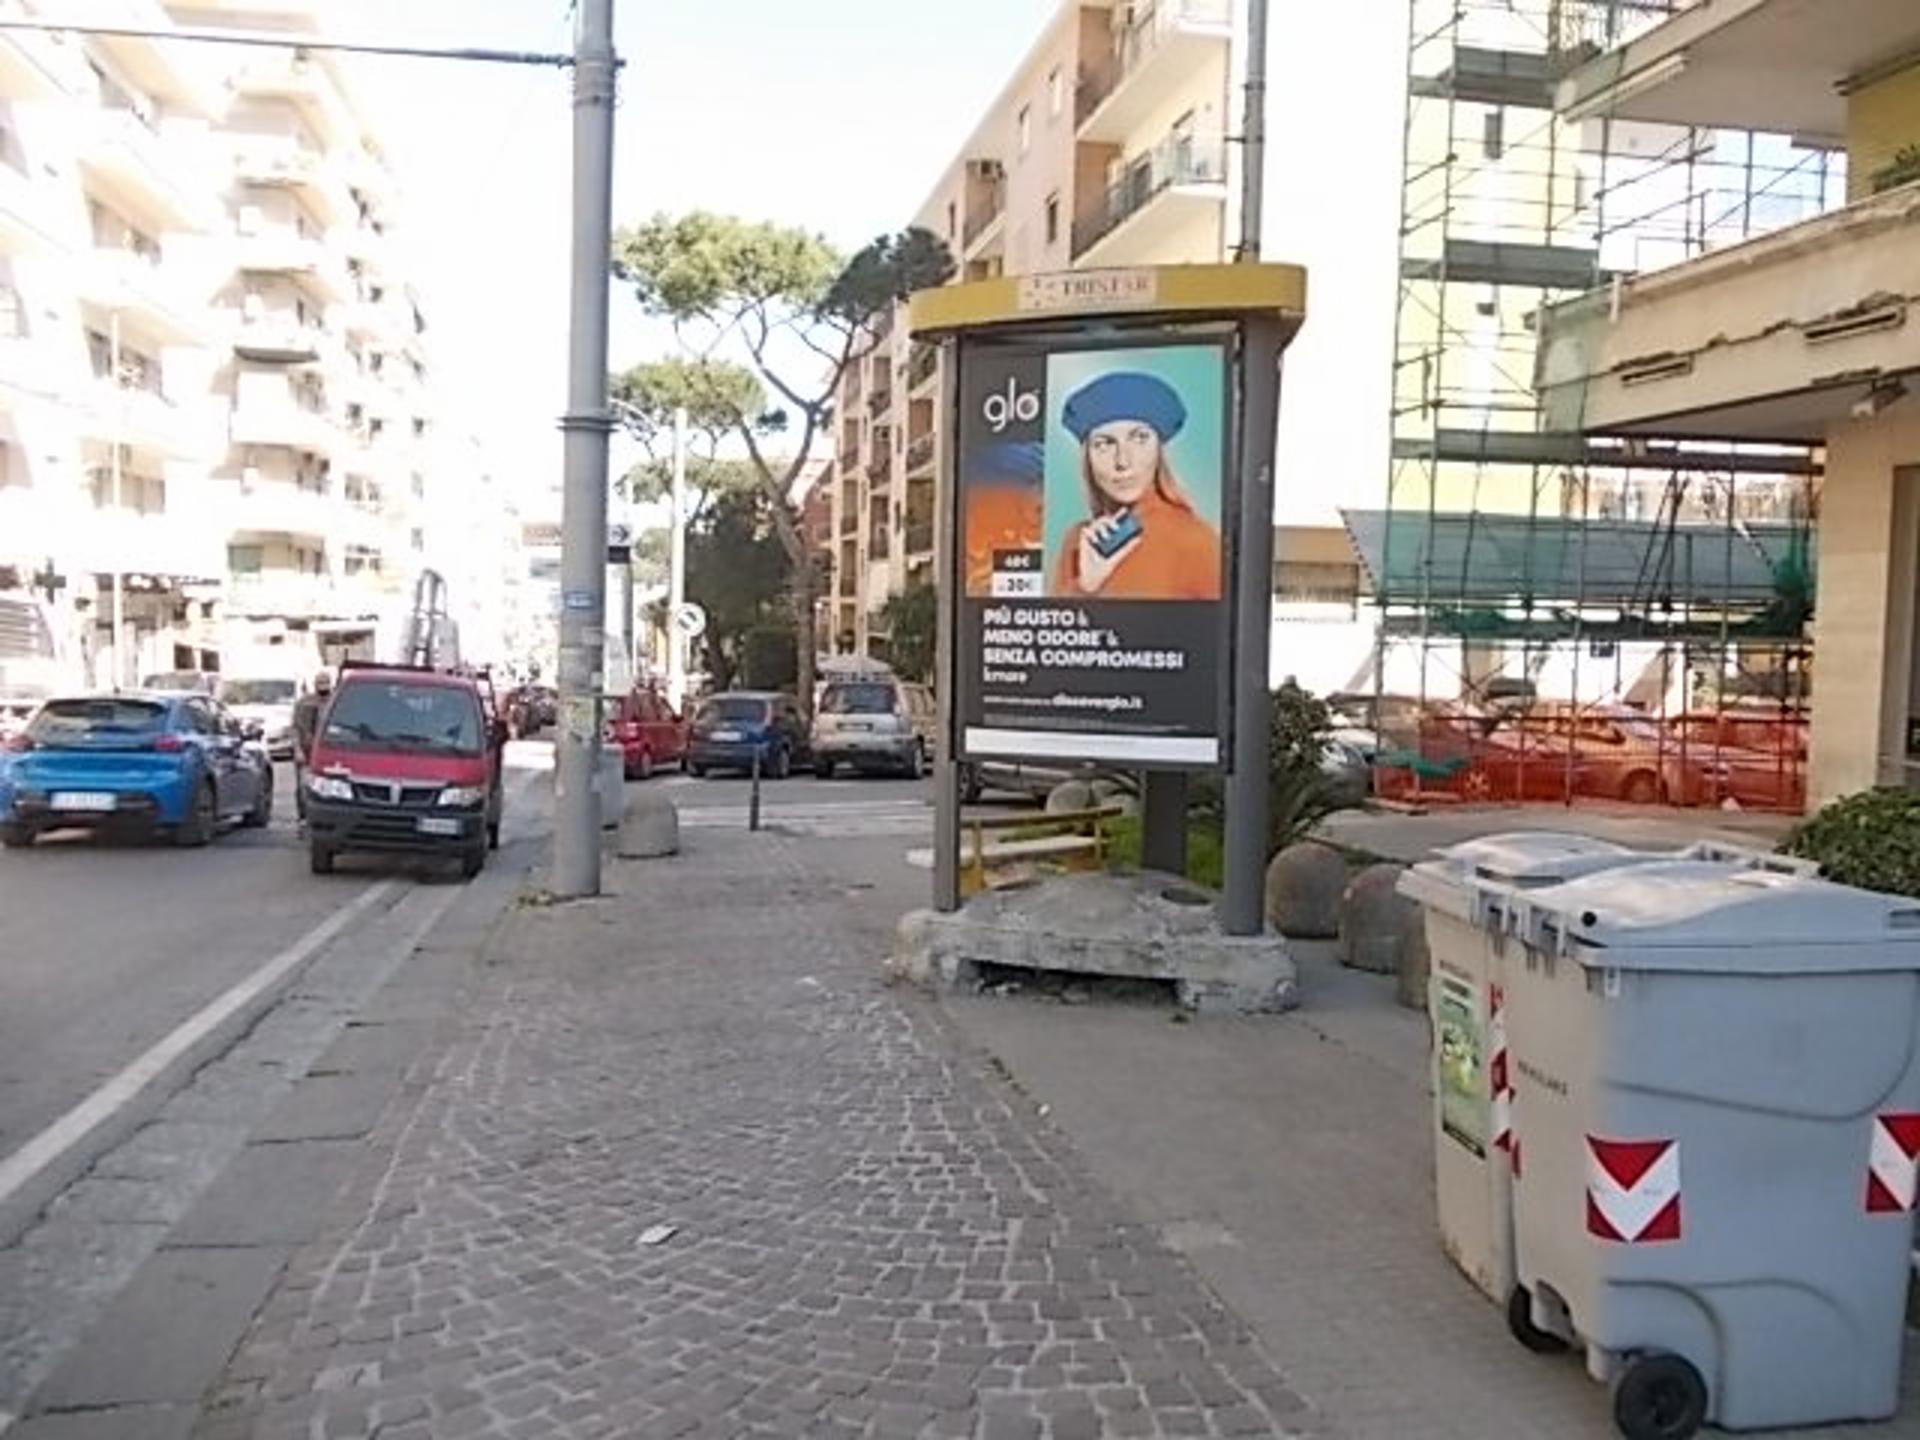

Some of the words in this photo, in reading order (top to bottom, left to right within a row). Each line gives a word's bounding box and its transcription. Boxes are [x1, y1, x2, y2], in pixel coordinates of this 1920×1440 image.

[983, 376, 1040, 433] glo
[983, 606, 1011, 626] PIÙ
[1013, 608, 1075, 626] GUSTO
[983, 629, 1033, 646] MENO
[983, 648, 1038, 666] SENZA
[1040, 650, 1185, 669] COMPROMESSI
